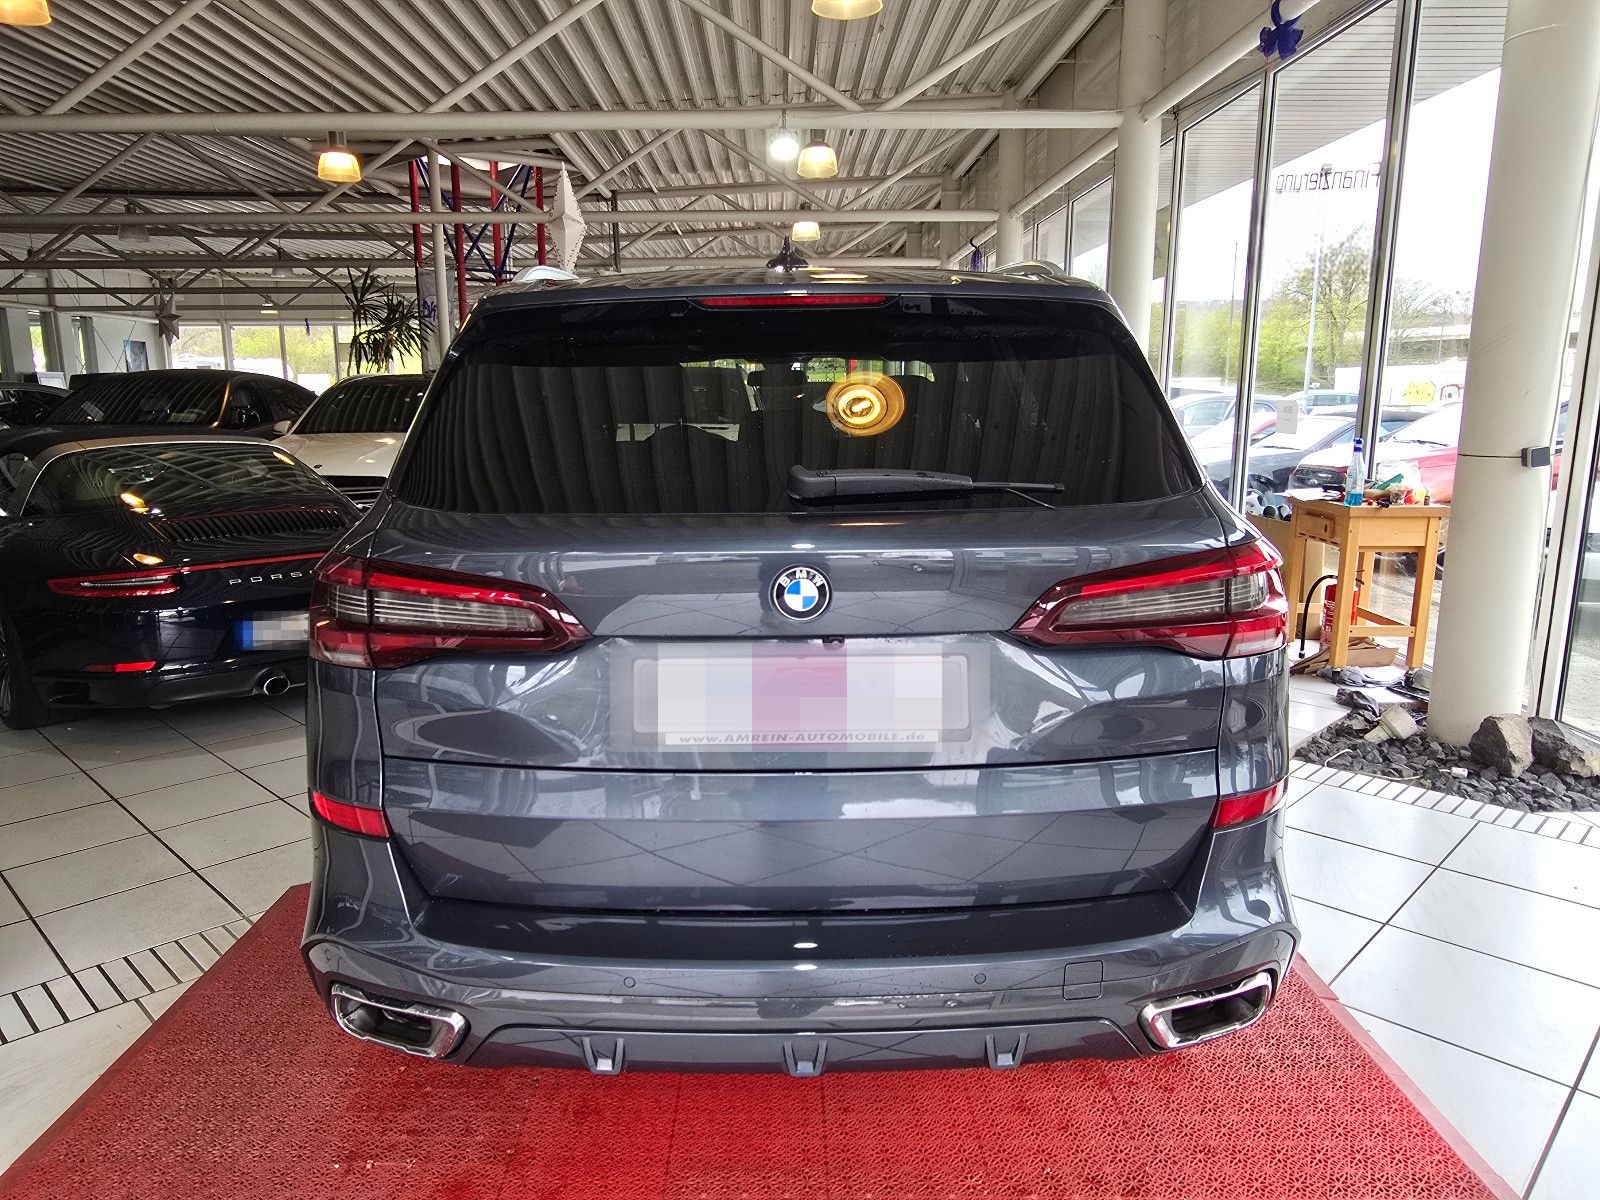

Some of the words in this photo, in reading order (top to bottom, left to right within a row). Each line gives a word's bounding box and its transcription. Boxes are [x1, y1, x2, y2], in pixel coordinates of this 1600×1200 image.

[228, 569, 313, 586] PORS
[779, 569, 824, 588] BMW
[679, 732, 925, 743] www.AMREIN-AUTOMOBILE.de
